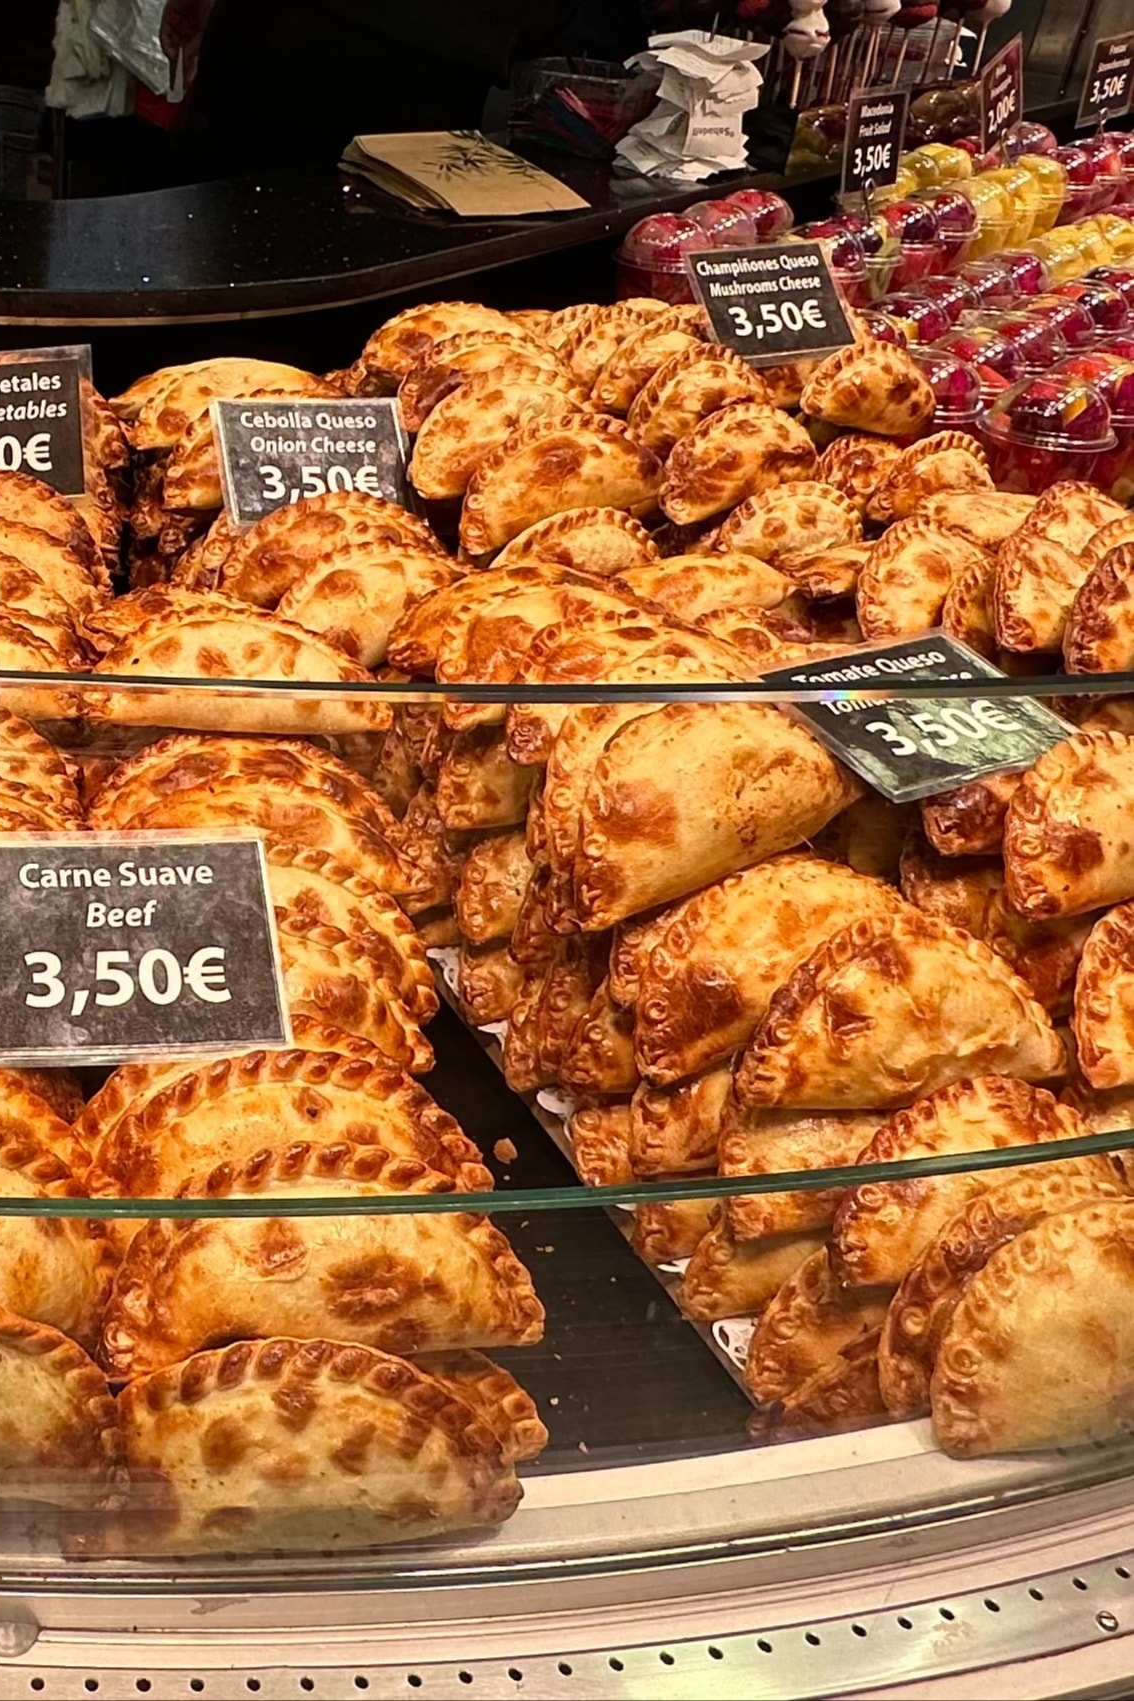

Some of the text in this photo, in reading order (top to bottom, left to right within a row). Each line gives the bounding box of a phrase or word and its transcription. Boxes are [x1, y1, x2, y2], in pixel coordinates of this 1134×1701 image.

[1089, 73, 1128, 104] 3,50€
[988, 89, 1016, 134] 2,00€
[853, 143, 892, 177] 3,50€
[696, 254, 819, 277] Champiñones Queso
[709, 276, 821, 297] Mushrooms Cheese
[728, 299, 827, 340] 3,50€
[240, 411, 377, 430] Cebolla Queso
[250, 437, 376, 453] Onion Cheese
[259, 465, 383, 504] 3,50€
[875, 651, 946, 674] Queso
[865, 700, 1022, 756] 3,50€
[19, 862, 214, 888] Carne Suave
[86, 900, 157, 928] Beef
[24, 946, 232, 1017] 3,50€
